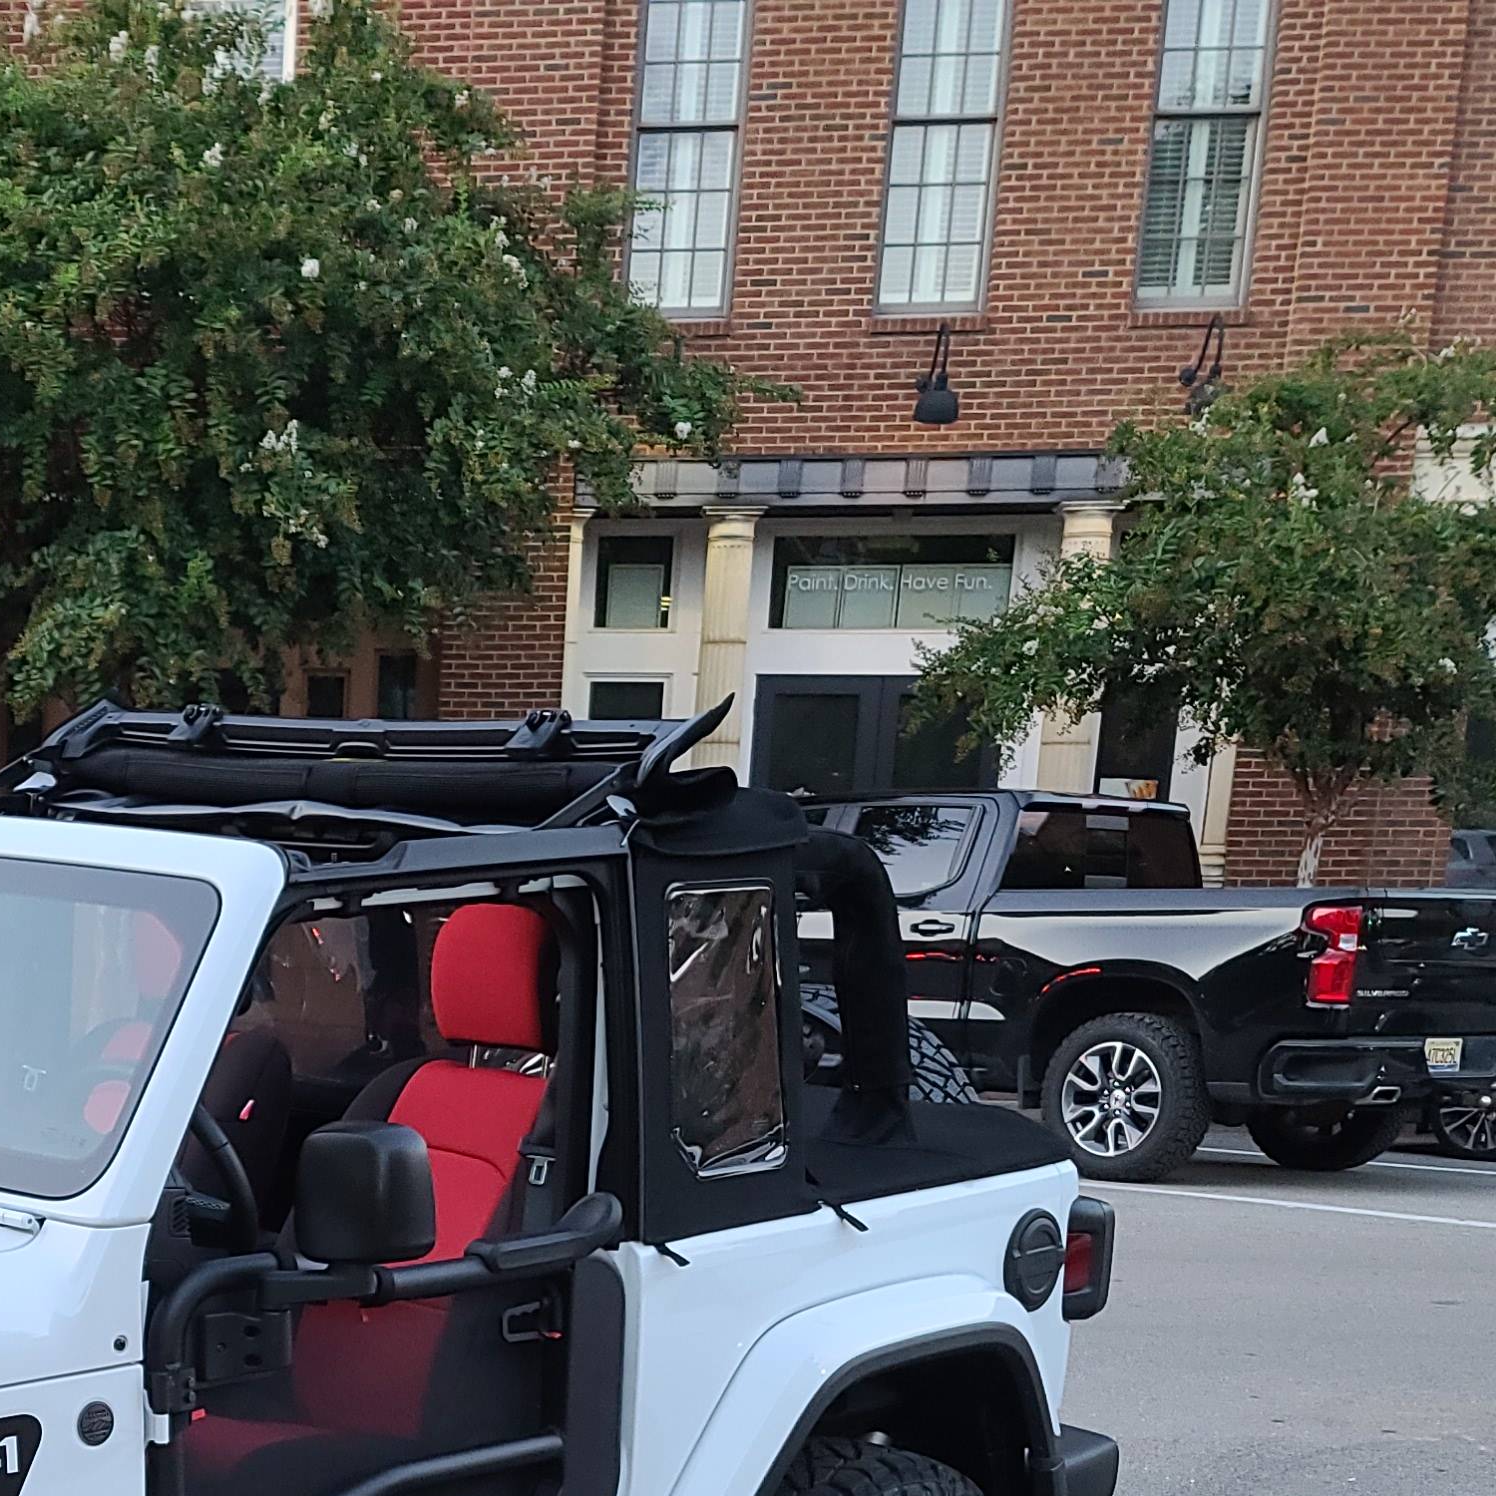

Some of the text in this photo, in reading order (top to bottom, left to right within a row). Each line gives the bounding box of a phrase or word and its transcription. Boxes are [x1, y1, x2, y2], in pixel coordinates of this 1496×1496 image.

[788, 573, 993, 591] Paint. Drink. Have Fun.
